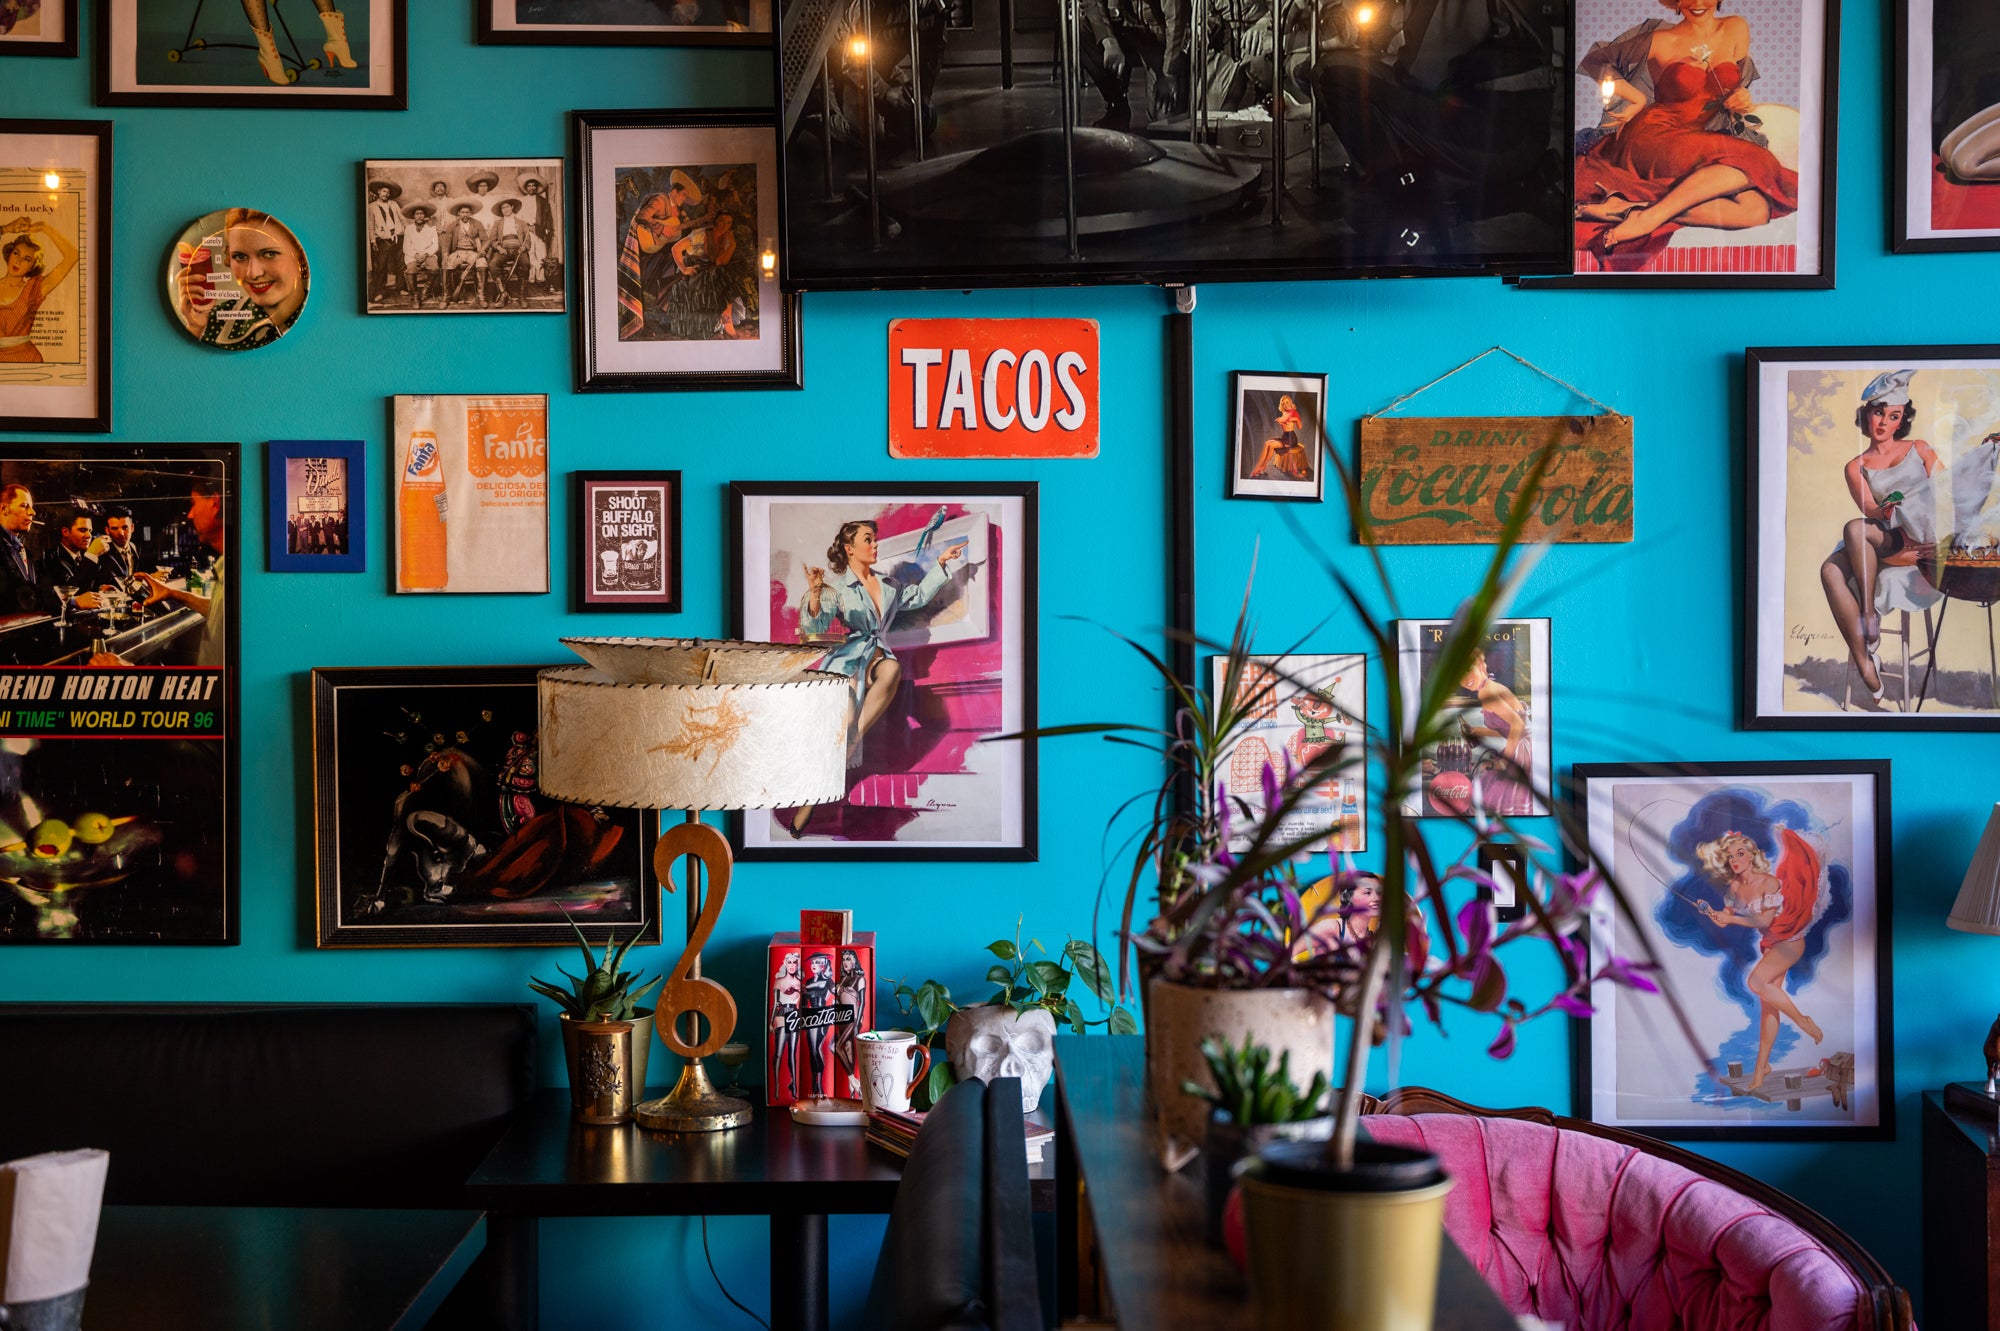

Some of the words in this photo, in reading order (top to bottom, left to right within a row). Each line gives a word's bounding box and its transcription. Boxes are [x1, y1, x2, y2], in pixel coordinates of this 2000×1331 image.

[24, 203, 54, 215] Lucky
[901, 347, 1088, 433] TACOS
[1430, 430, 1533, 447] DRINK
[407, 442, 436, 476] Fanta
[476, 482, 527, 490] DELICIOSA
[1360, 443, 1634, 528] Coca-Cola
[494, 490, 507, 498] SU
[509, 490, 546, 498] ORIGEN
[608, 495, 648, 510] SHOOT
[602, 510, 654, 524] BUFFALO
[602, 524, 619, 538] ON
[620, 524, 655, 537] SIGHT
[0, 675, 56, 701] REND
[61, 675, 155, 701] HORTON
[159, 675, 219, 701] HEAT
[16, 711, 65, 729] TIME"
[70, 711, 137, 729] WORLD
[141, 711, 190, 729] TOUR
[193, 711, 215, 729] 96
